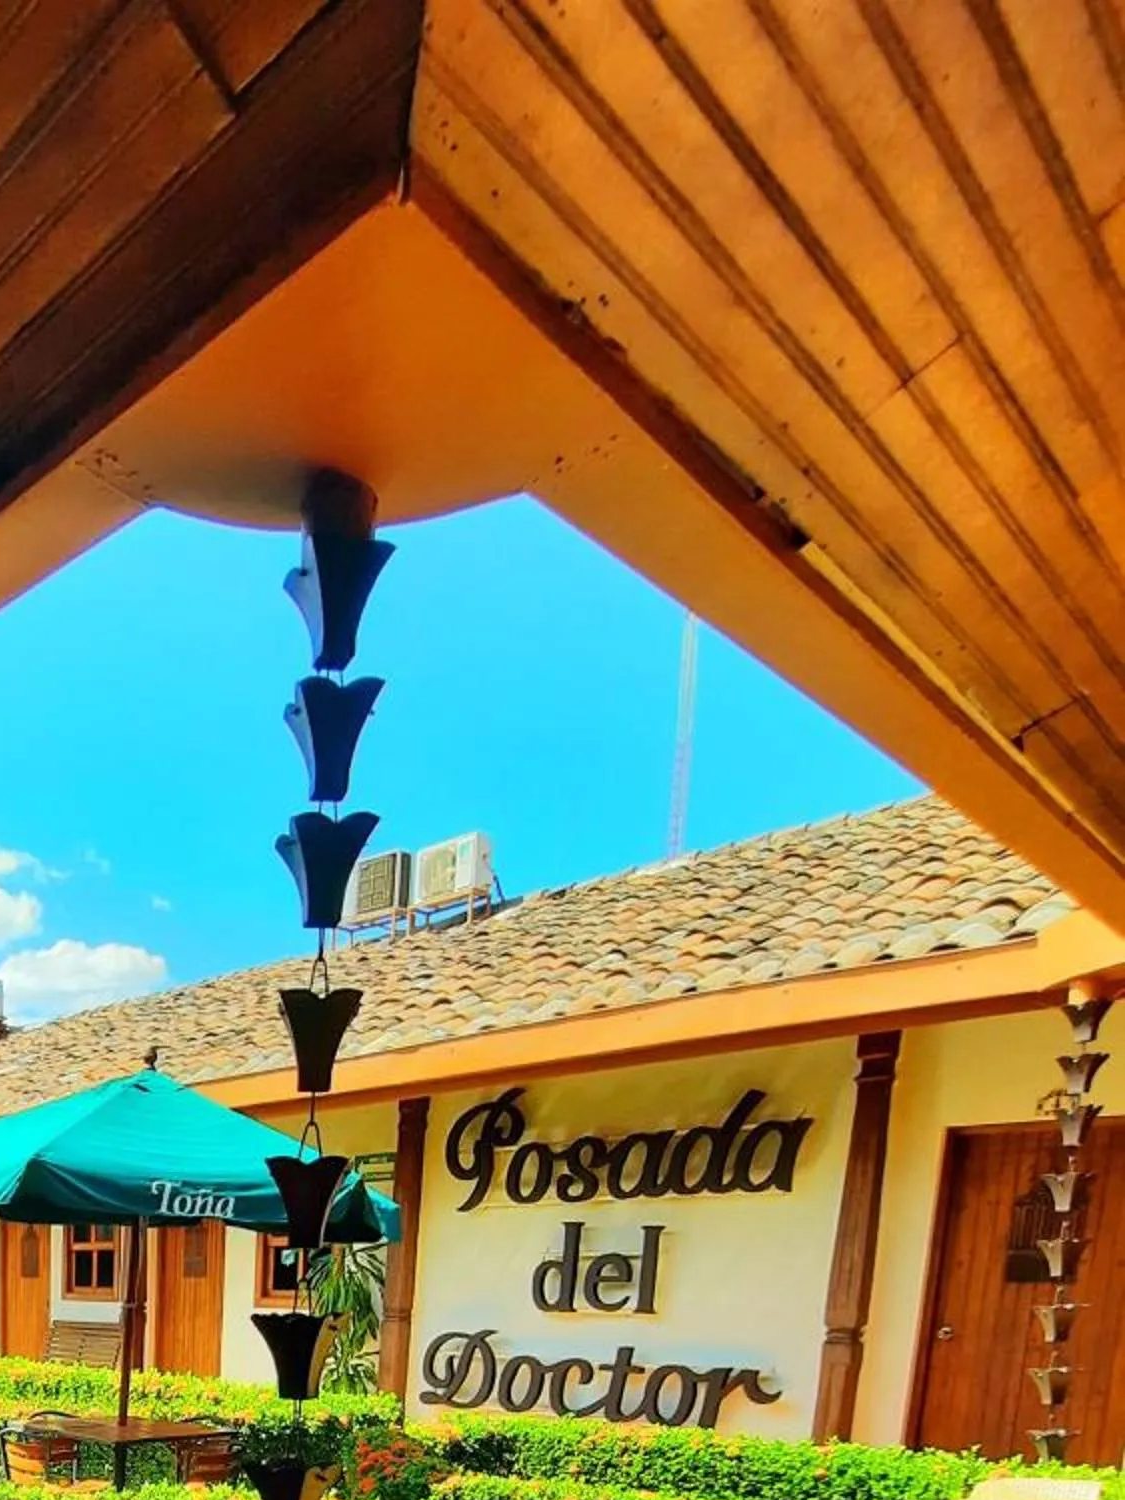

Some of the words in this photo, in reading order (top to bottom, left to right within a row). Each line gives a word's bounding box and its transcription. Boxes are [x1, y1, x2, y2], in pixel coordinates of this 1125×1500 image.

[445, 1087, 815, 1211] Posada
[151, 1180, 235, 1218] Toña
[532, 1221, 666, 1314] del
[419, 1329, 783, 1429] Doctor
